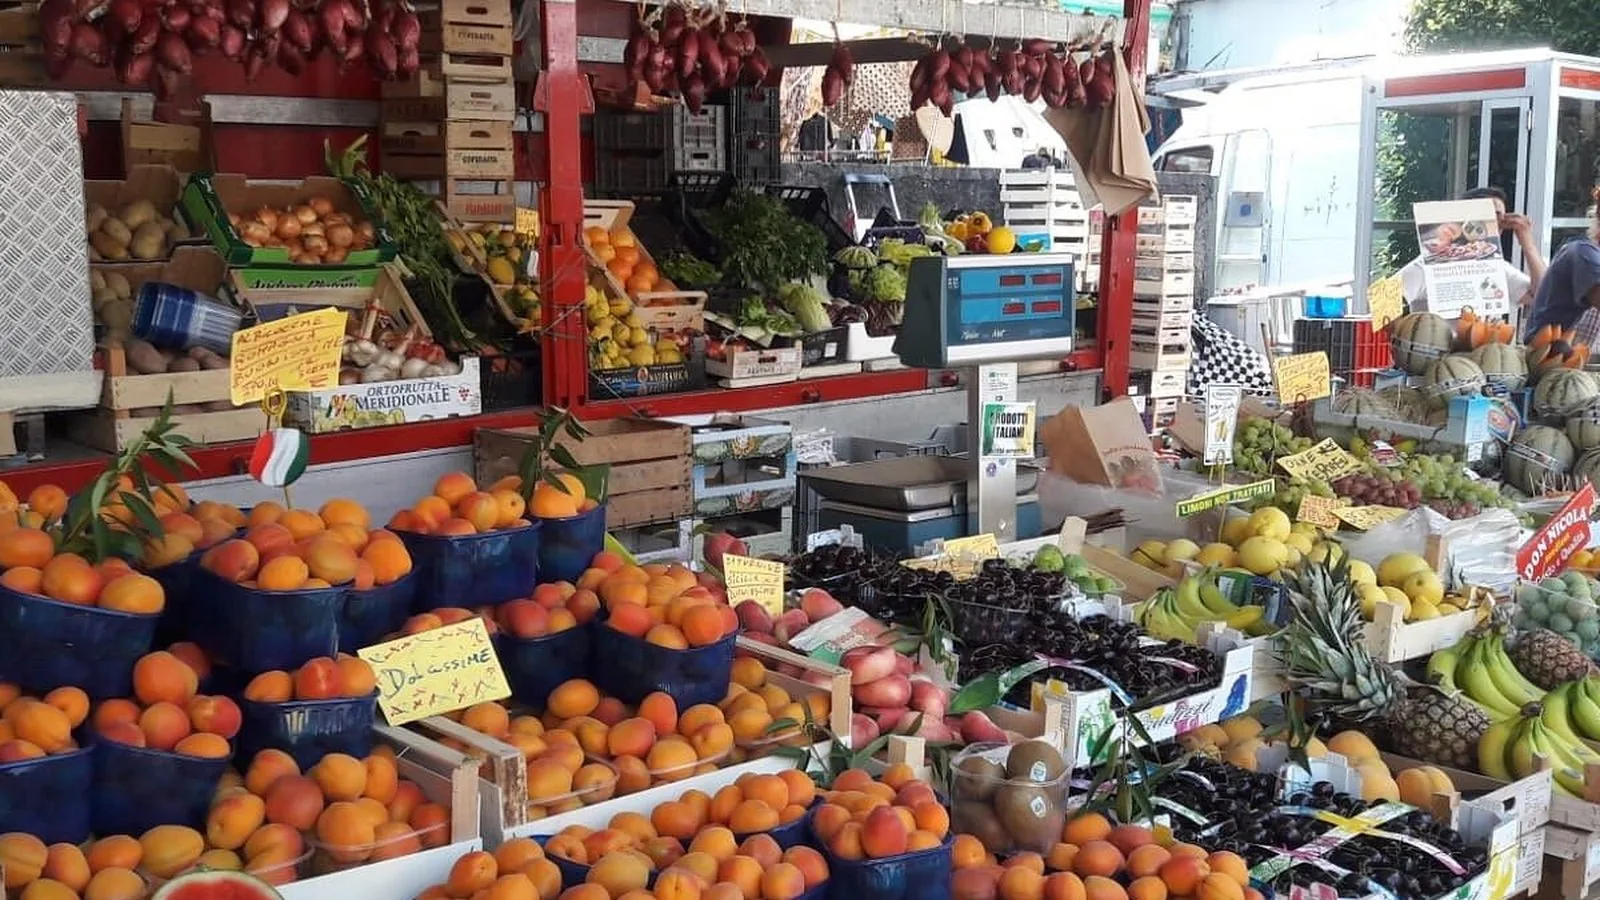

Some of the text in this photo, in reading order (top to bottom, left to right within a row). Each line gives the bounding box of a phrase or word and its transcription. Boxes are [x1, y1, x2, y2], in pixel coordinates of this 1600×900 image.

[355, 387, 451, 410] MERIDIONALE
[366, 381, 441, 397] ORTOFRUTTA
[990, 412, 1029, 425] PRODOTTI
[992, 426, 1025, 439] ITALIANI
[1181, 484, 1271, 515] LIMONI NON TRATTATI
[1525, 536, 1548, 579] DON
[1546, 507, 1588, 543] NICOLA
